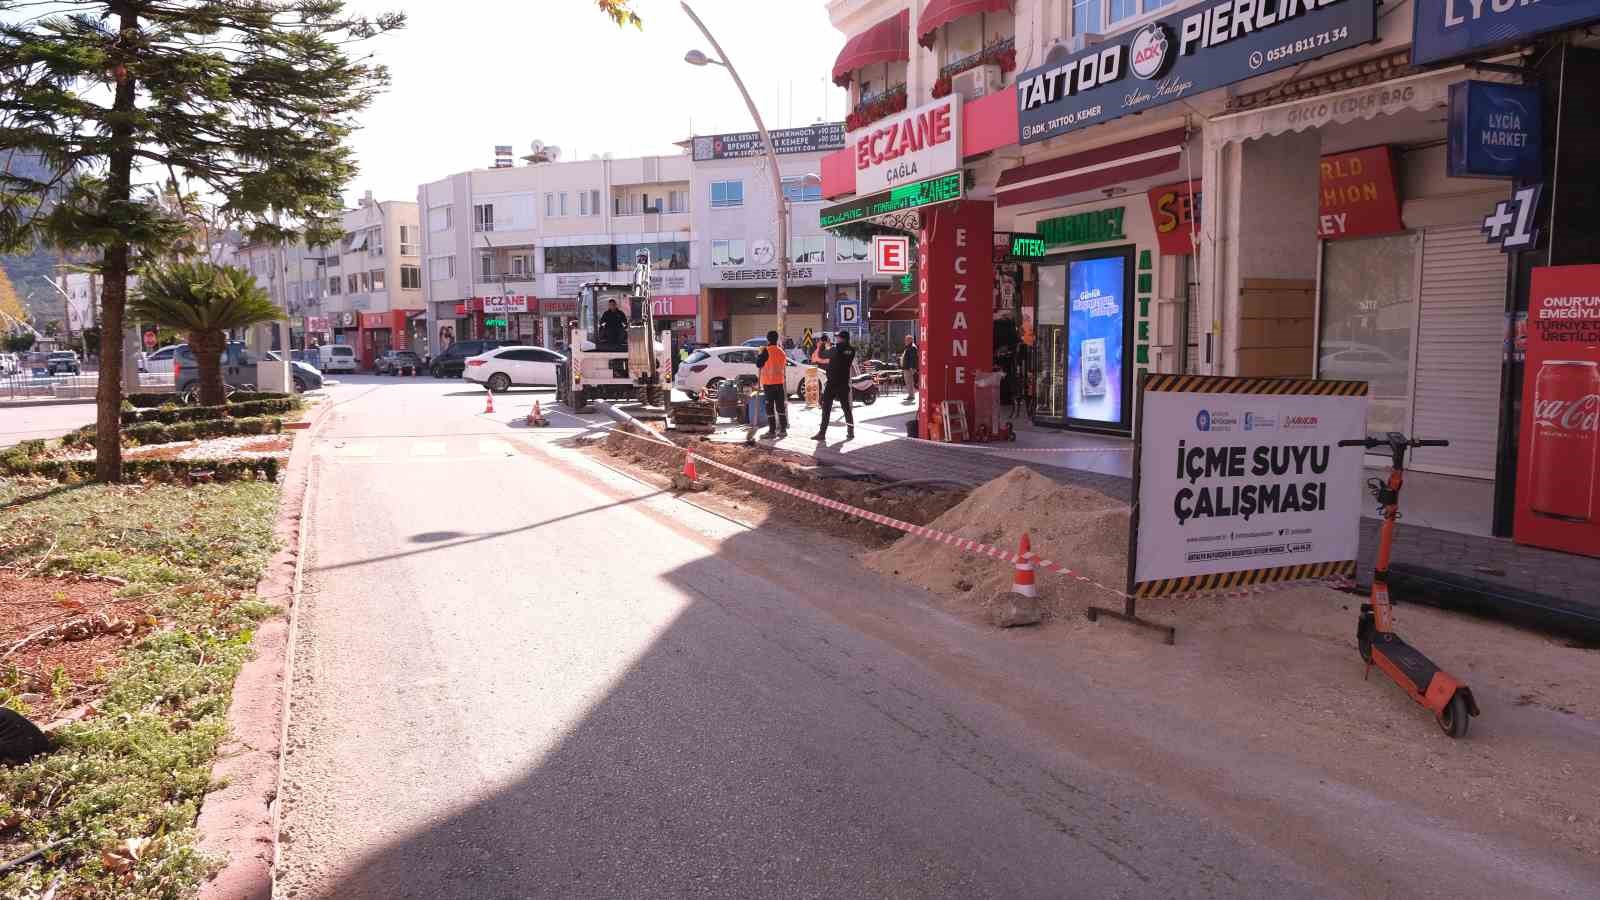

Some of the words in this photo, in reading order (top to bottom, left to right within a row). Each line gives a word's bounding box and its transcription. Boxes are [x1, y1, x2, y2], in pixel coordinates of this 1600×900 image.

[1266, 43, 1294, 62] 0534
[1018, 45, 1121, 112] TATTOO
[857, 103, 951, 171] ECZANE
[1481, 129, 1528, 148] MARKET
[886, 161, 918, 184] ÇAĞLA
[884, 244, 900, 267] E
[1013, 238, 1046, 257] АПТЕКА
[652, 296, 673, 316] nti
[952, 228, 968, 384] ECZANE
[1136, 249, 1153, 376] АПТЕК
[1539, 306, 1600, 319] EMEĞİYL
[1176, 440, 1247, 484] İÇME
[1251, 444, 1330, 477] SUYU
[1174, 481, 1327, 526] ÇALIŞMASI
